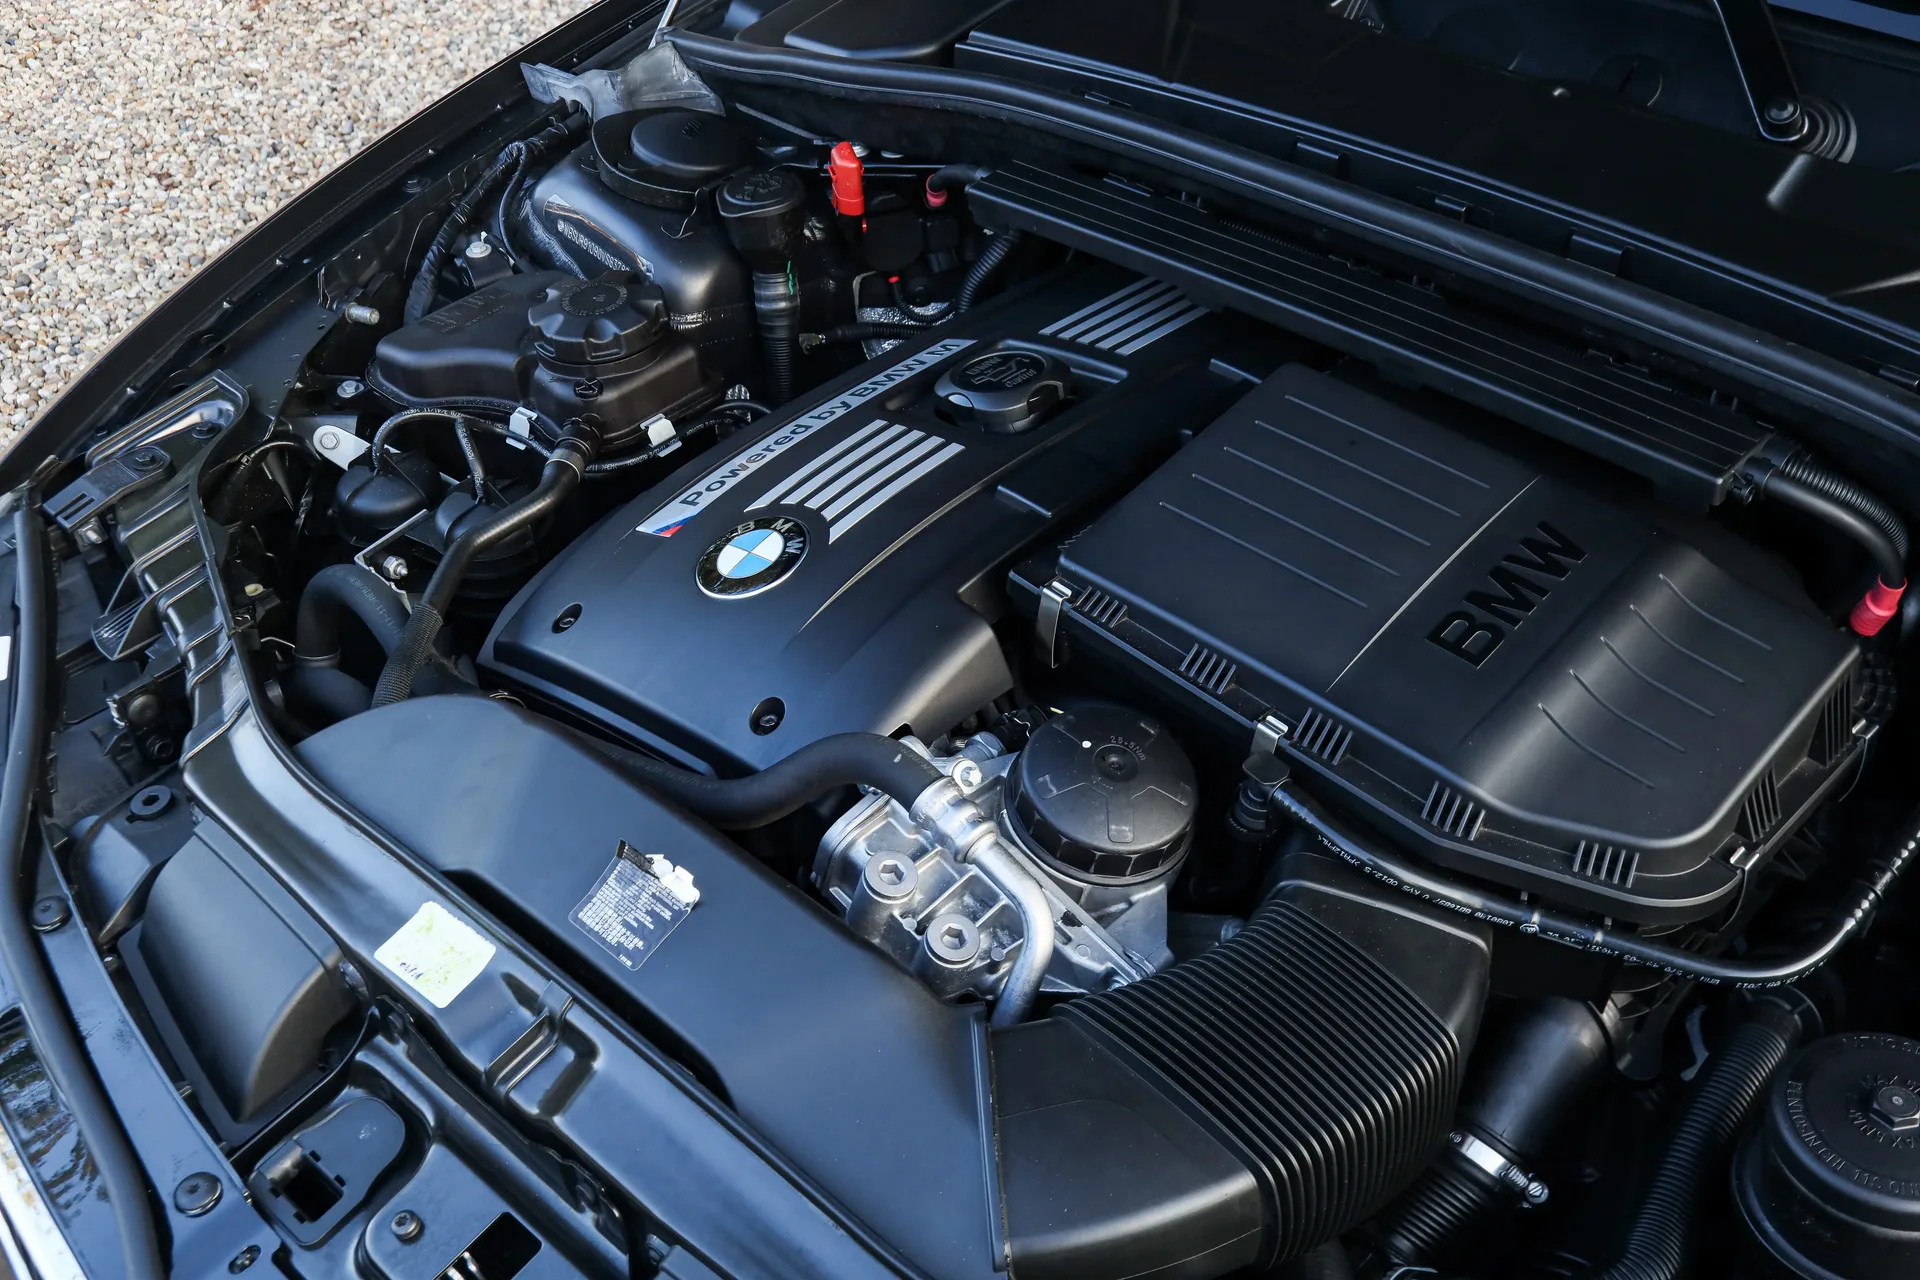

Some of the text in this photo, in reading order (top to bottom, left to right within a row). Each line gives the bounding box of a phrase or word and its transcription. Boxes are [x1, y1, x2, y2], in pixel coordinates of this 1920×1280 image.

[965, 356, 1002, 375] BMW
[1005, 369, 1037, 388] Castrol
[679, 423, 810, 506] Powered
[808, 400, 852, 421] by
[850, 359, 928, 398] BMW
[929, 342, 961, 357] M
[737, 518, 804, 554] BMW
[1424, 520, 1588, 670] BMW
